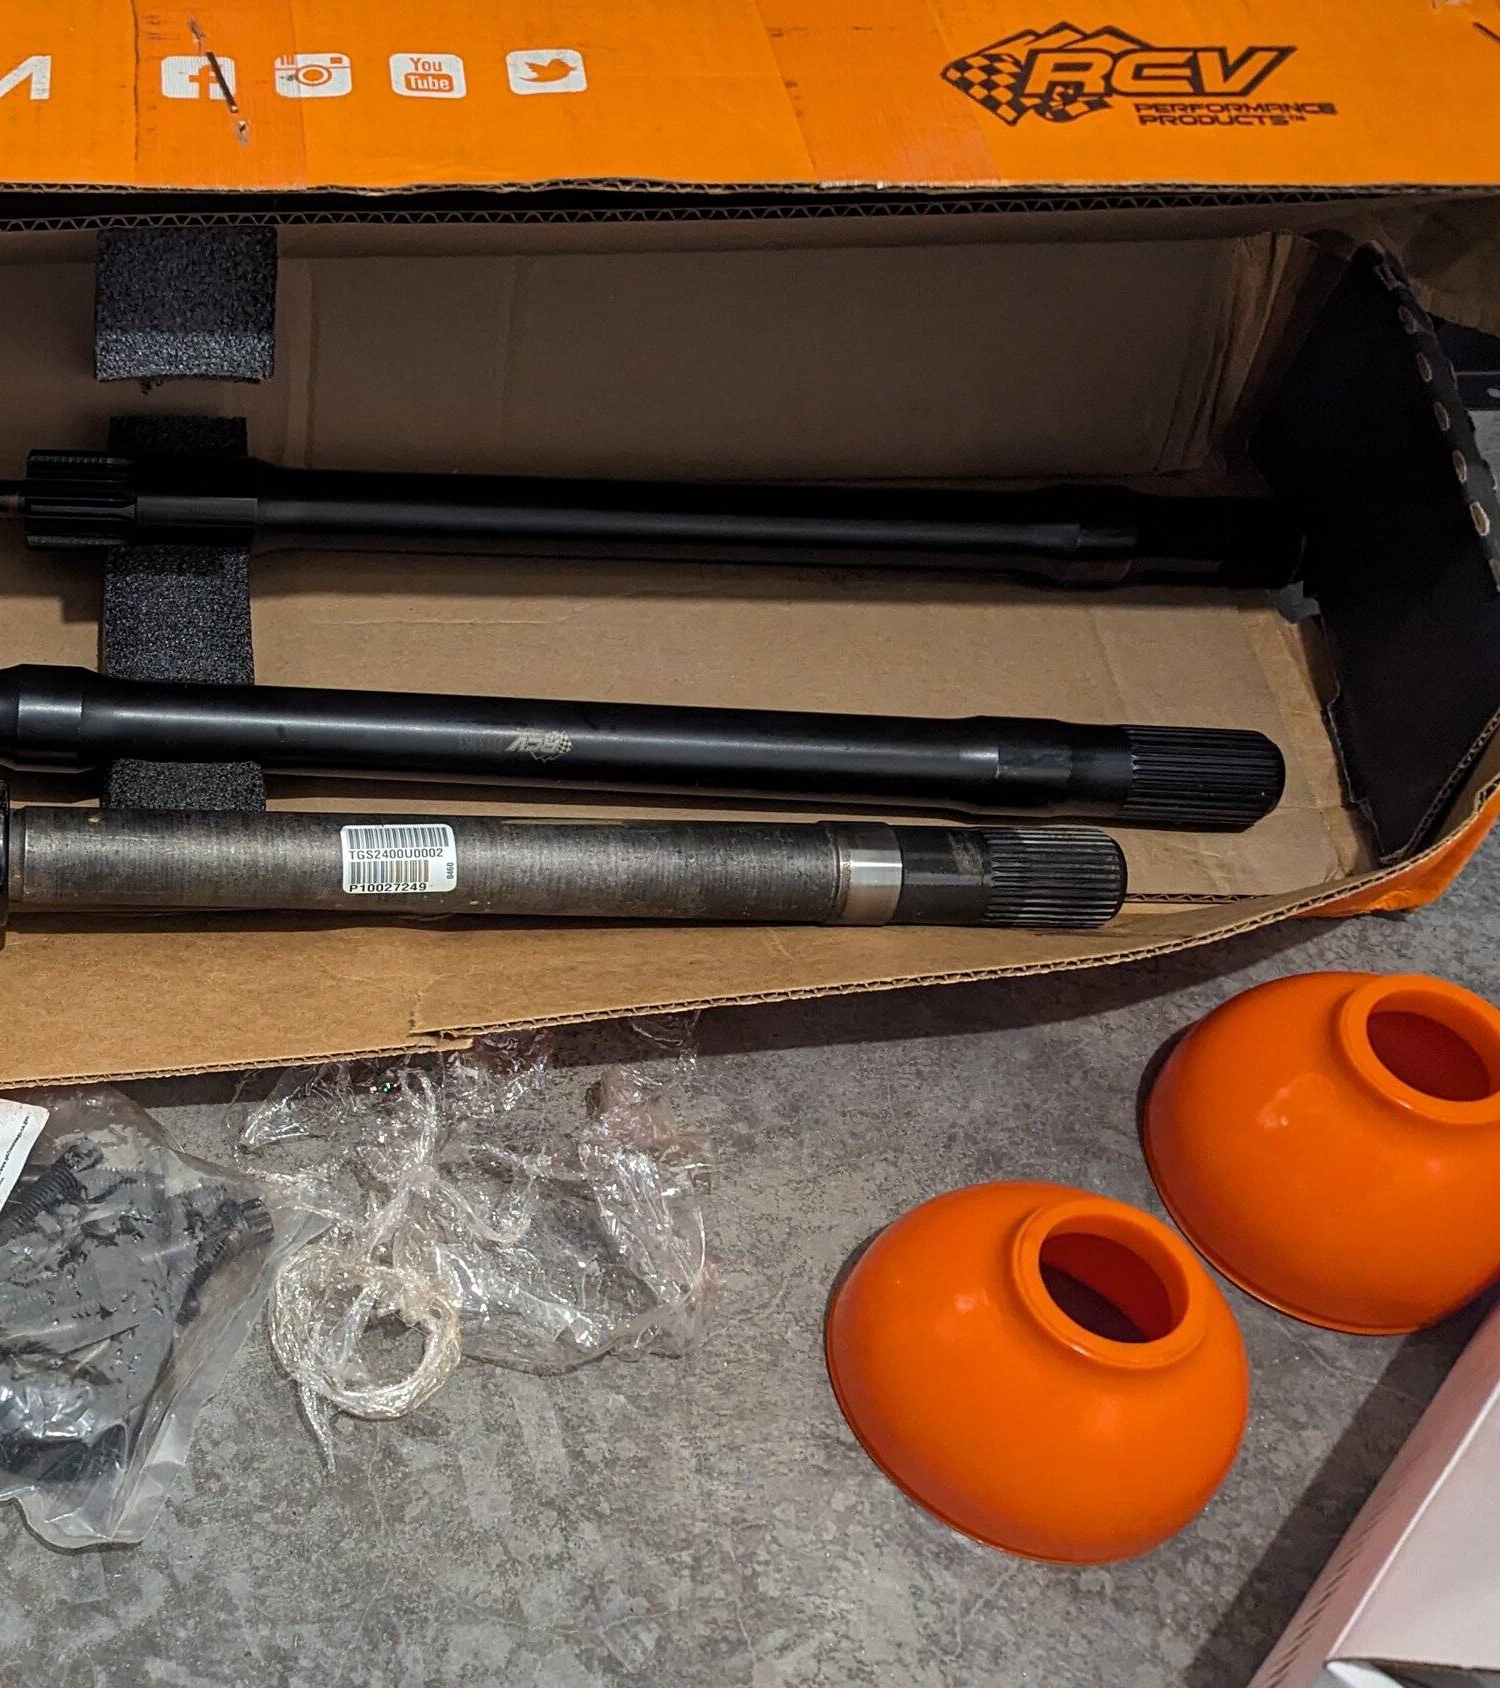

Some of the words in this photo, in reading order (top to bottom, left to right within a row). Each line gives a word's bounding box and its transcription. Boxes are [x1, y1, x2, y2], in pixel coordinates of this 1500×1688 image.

[410, 57, 443, 72] You
[1022, 46, 1298, 97] RCV
[407, 75, 450, 90] Tube
[1134, 102, 1338, 115] PERFORMANCE
[349, 848, 444, 861] TGS2400U0002
[350, 882, 427, 892] P10027249
